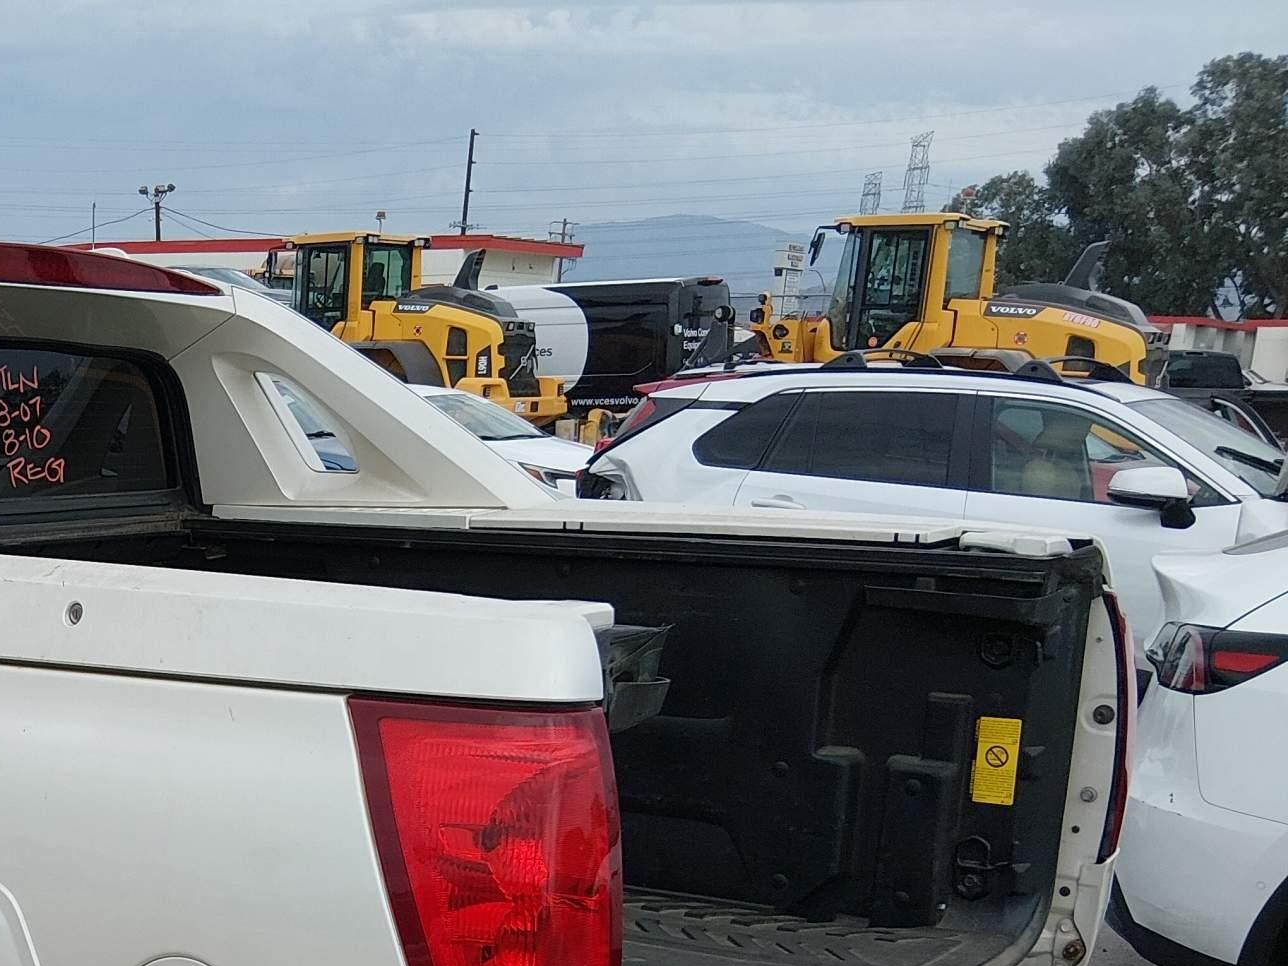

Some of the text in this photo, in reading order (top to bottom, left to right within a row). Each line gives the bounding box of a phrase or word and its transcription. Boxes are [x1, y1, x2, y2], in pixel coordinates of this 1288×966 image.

[398, 304, 430, 312] VOLVO
[990, 305, 1037, 315] VOLVO
[2, 425, 51, 456] 8-10
